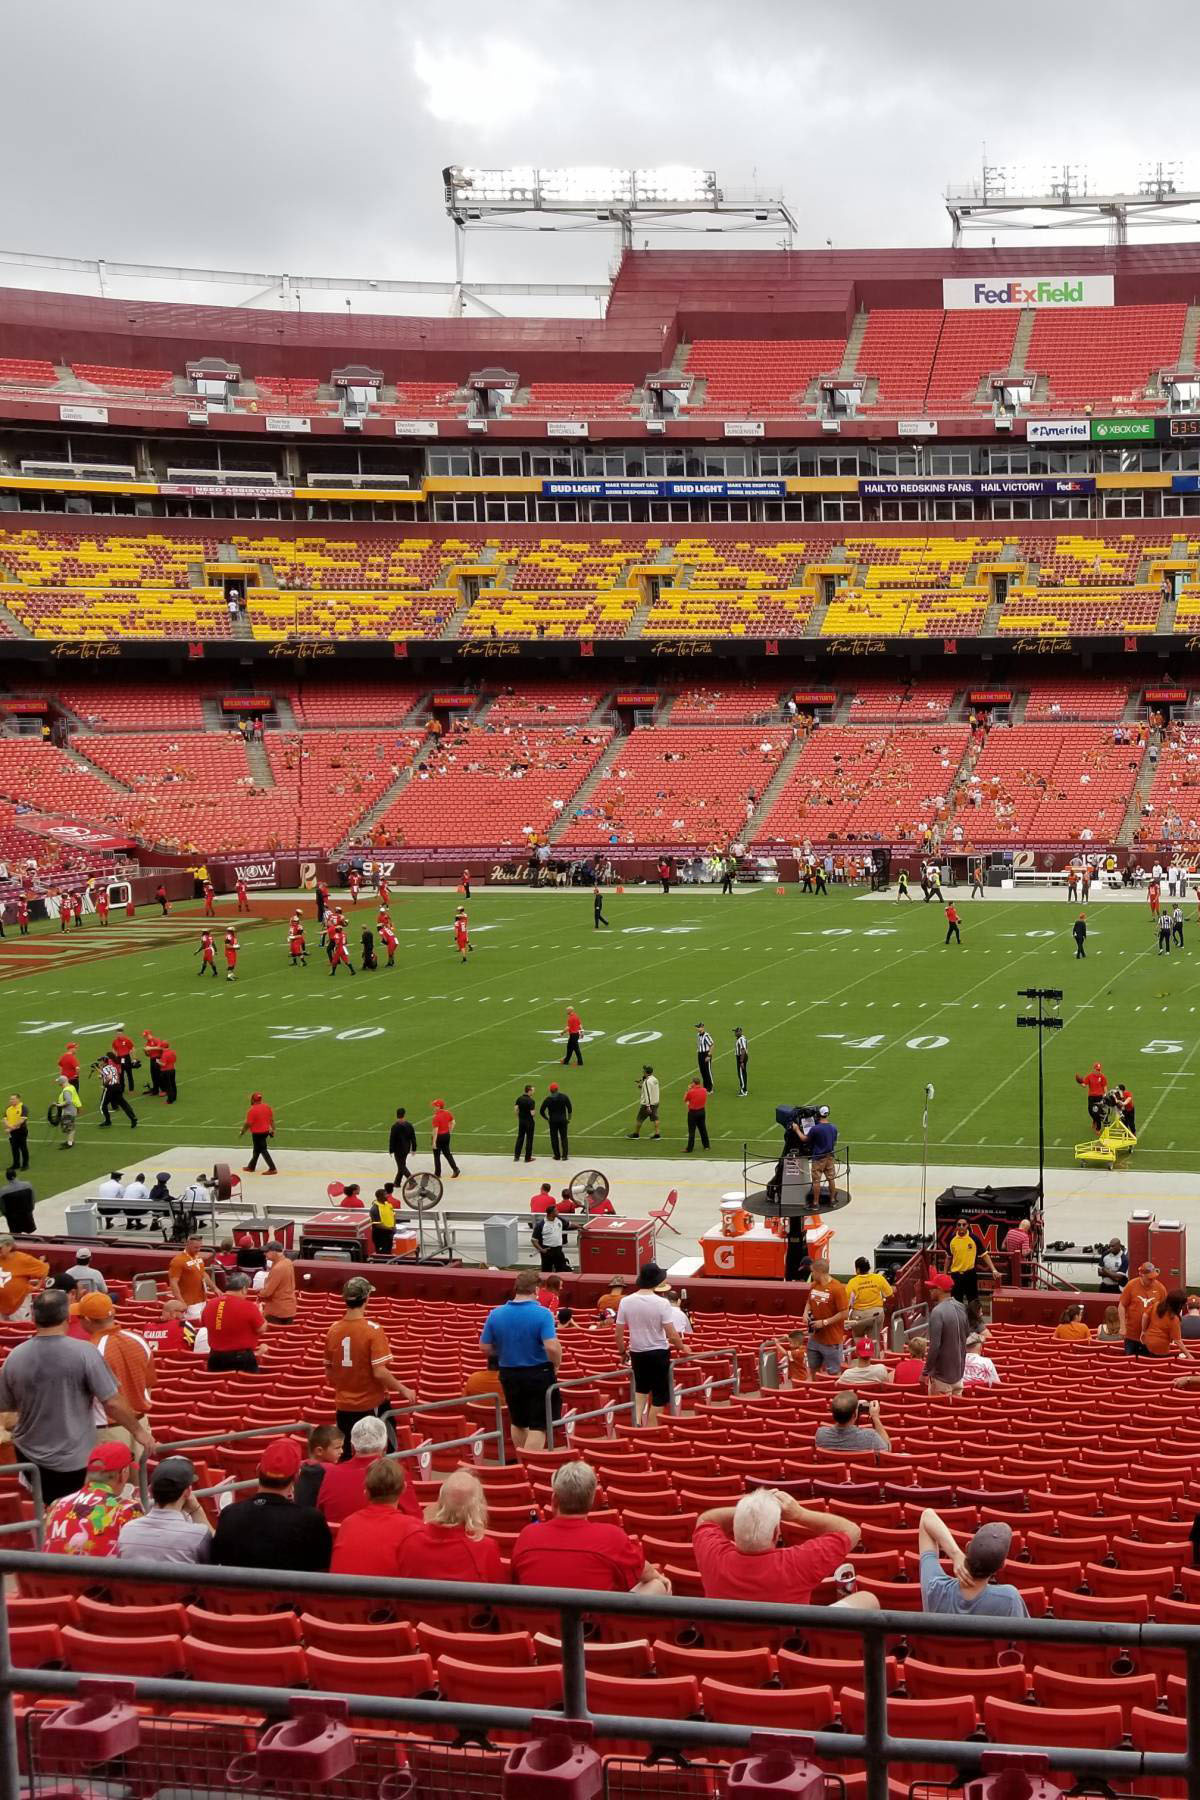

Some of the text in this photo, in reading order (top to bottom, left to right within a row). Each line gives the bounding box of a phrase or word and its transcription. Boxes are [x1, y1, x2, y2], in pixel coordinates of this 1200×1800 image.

[974, 281, 1083, 304] FedExField
[1109, 425, 1150, 434] XBOX ONE
[551, 485, 601, 493] BUD LIGHT
[673, 485, 723, 493] BUD LIGHT
[864, 483, 974, 493] HAIL TO REDSKINS FANS.
[981, 481, 1044, 492] HAIL VICTORY!
[1057, 482, 1081, 491] FedEx
[714, 1246, 735, 1269] G
[341, 1336, 353, 1367] 1
[51, 1520, 68, 1539] M
